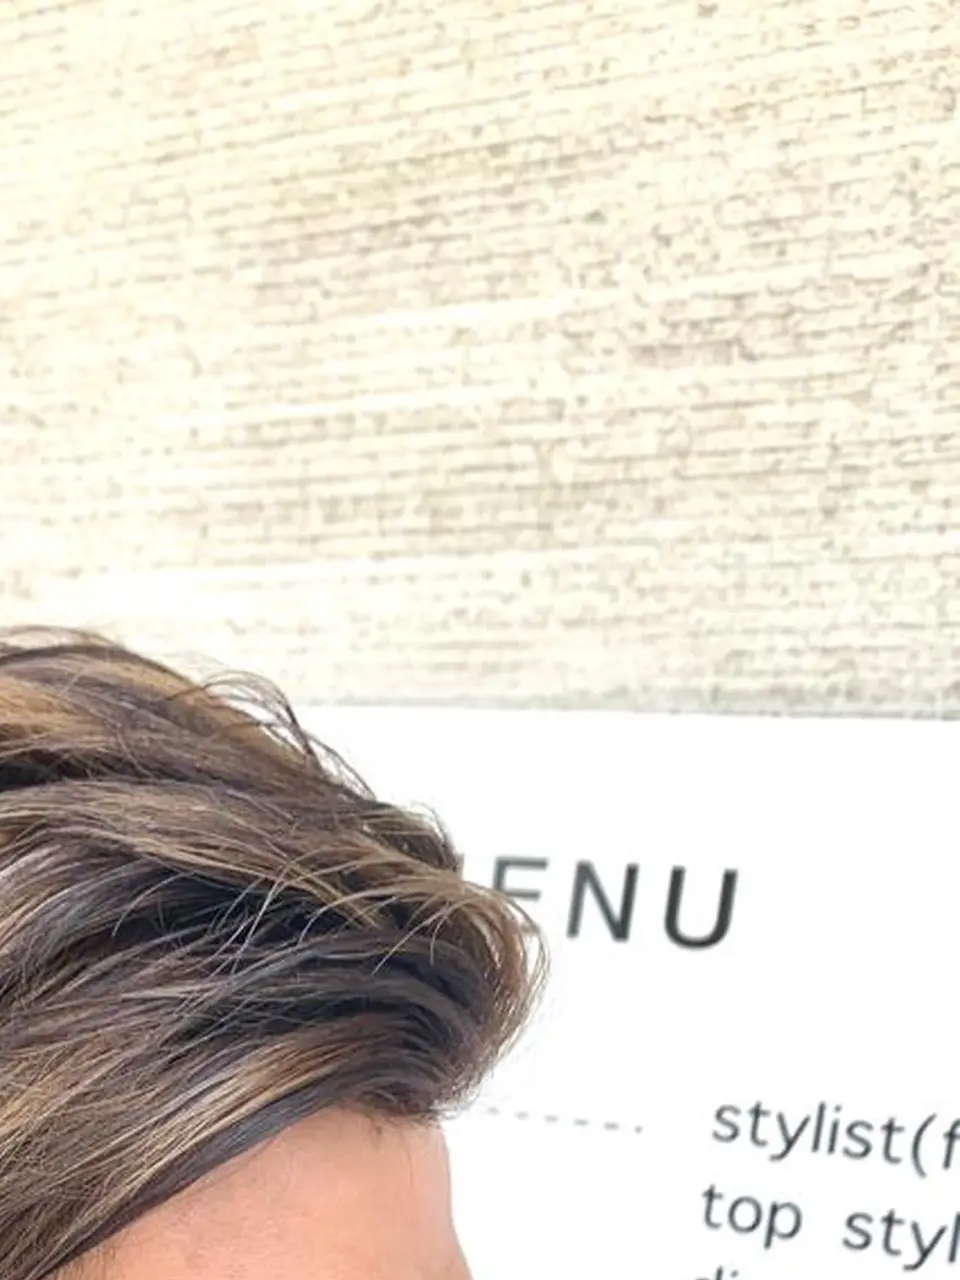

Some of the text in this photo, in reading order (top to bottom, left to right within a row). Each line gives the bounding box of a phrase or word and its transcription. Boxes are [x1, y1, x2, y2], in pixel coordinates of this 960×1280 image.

[456, 854, 738, 950] ENU
[712, 1101, 960, 1178] stylist(f
[702, 1185, 960, 1272] top styl
